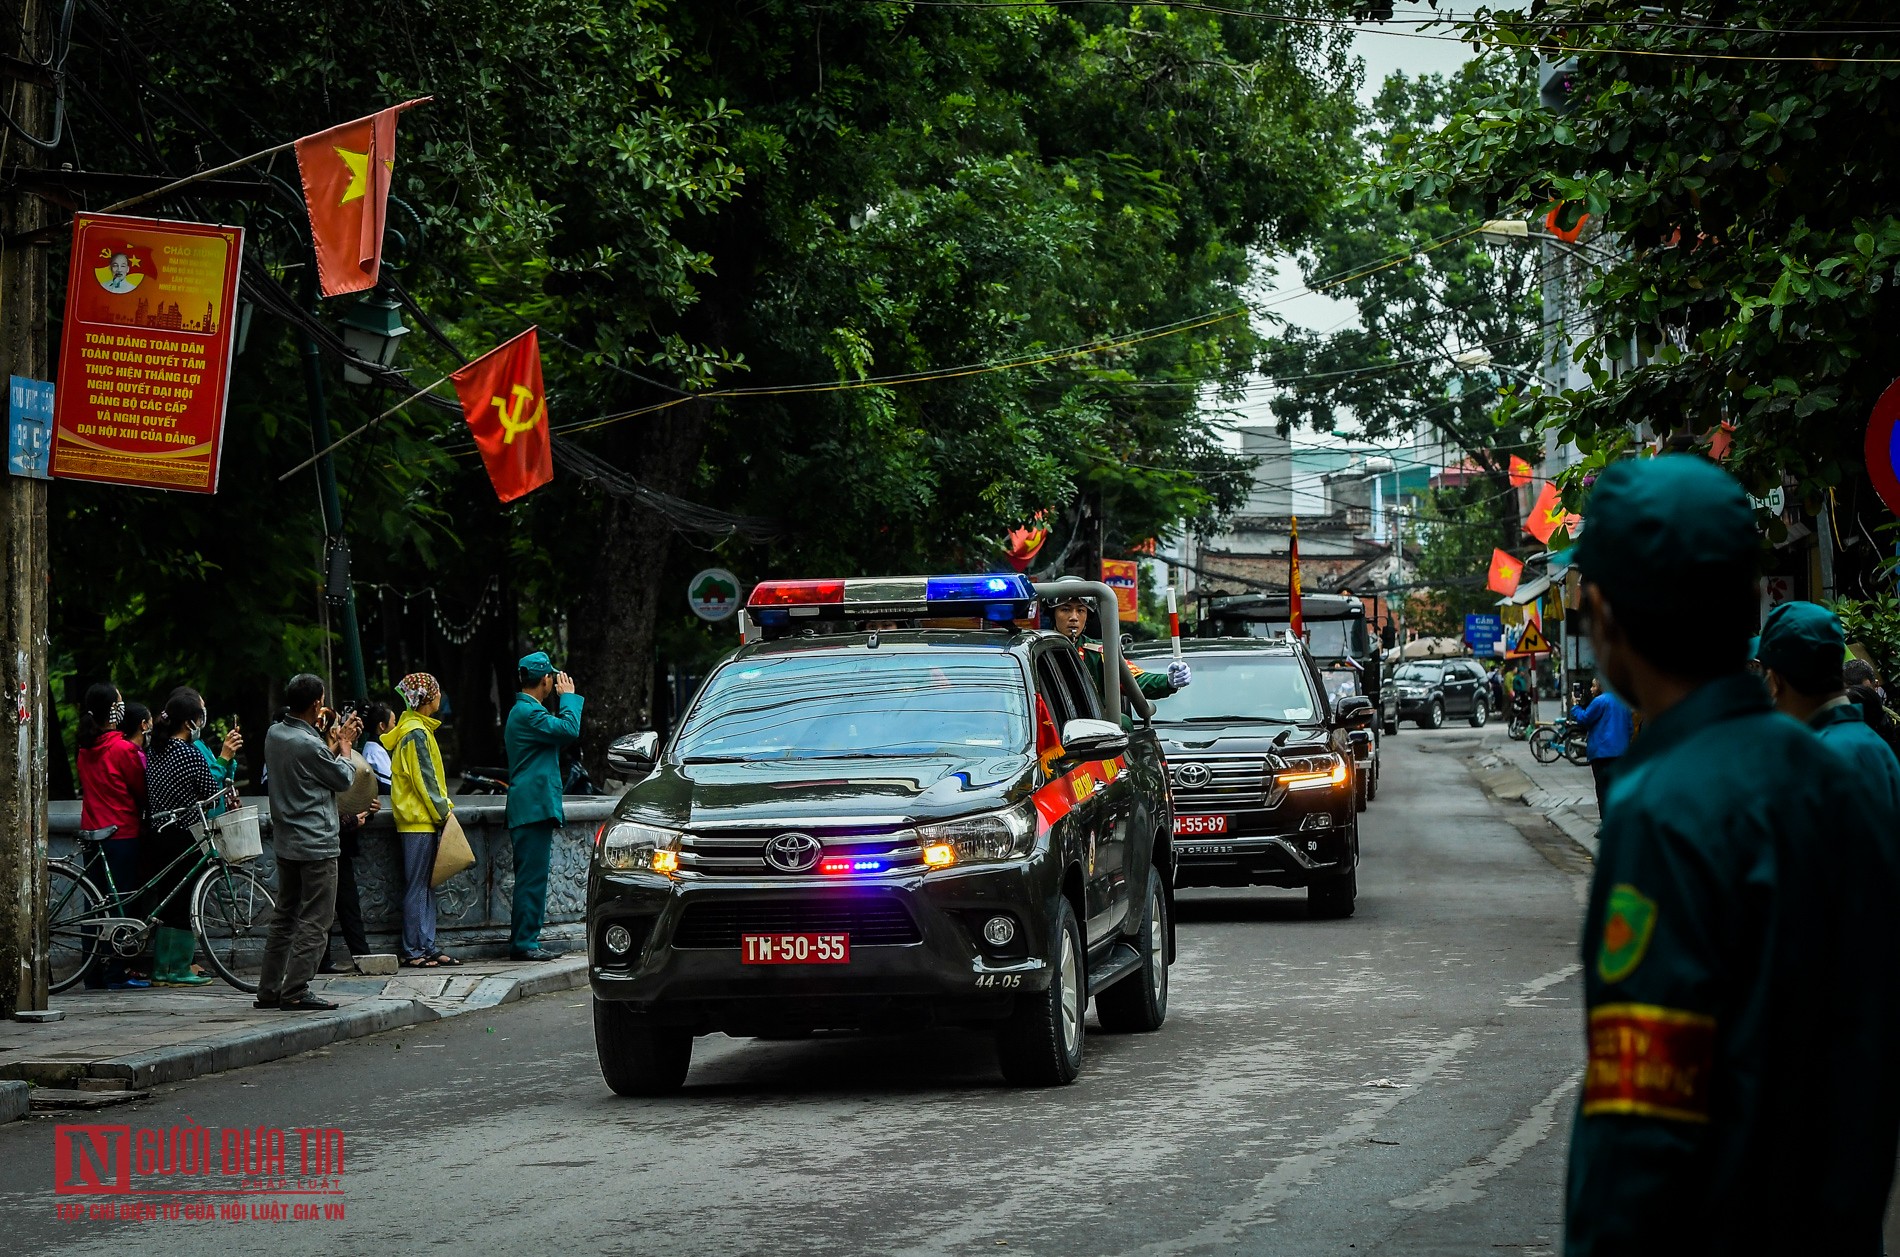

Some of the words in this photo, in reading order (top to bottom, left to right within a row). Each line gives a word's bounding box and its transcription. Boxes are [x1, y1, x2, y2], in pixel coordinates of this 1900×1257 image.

[85, 333, 115, 345] TOÀN
[116, 335, 147, 348] ĐẢNG
[150, 340, 178, 352] TOÀN
[181, 342, 204, 354] DÂN
[81, 347, 110, 360] TOÀN
[112, 351, 142, 363] QUÂN
[145, 354, 179, 367] QUYẾT
[182, 357, 206, 370] TÂM
[85, 363, 113, 377] THỰC
[116, 366, 142, 380] HIỆN
[145, 368, 181, 382] THẮNG
[183, 374, 201, 386] LỢI
[87, 379, 114, 392] NGHỊ
[116, 382, 151, 395] QUYẾT
[152, 386, 172, 398] ĐẠI
[174, 387, 193, 400] HỘI
[89, 393, 120, 407] ĐẢNG
[122, 398, 137, 410] BỘ
[140, 399, 162, 411] CÁC
[164, 401, 187, 413] CẤP
[97, 410, 111, 421] VÀ
[113, 412, 140, 426] NGHỊ
[142, 415, 177, 428] QUYẾT
[77, 423, 96, 436] ĐẠI
[98, 425, 117, 438] HỘI
[119, 428, 138, 440] XIII
[140, 428, 162, 442] CỦA
[165, 431, 196, 445] ĐẢNG
[1173, 816, 1225, 833] M-55-89
[1307, 841, 1317, 851] 50
[745, 935, 845, 961] TM-50-55
[974, 974, 1022, 988] 44-05
